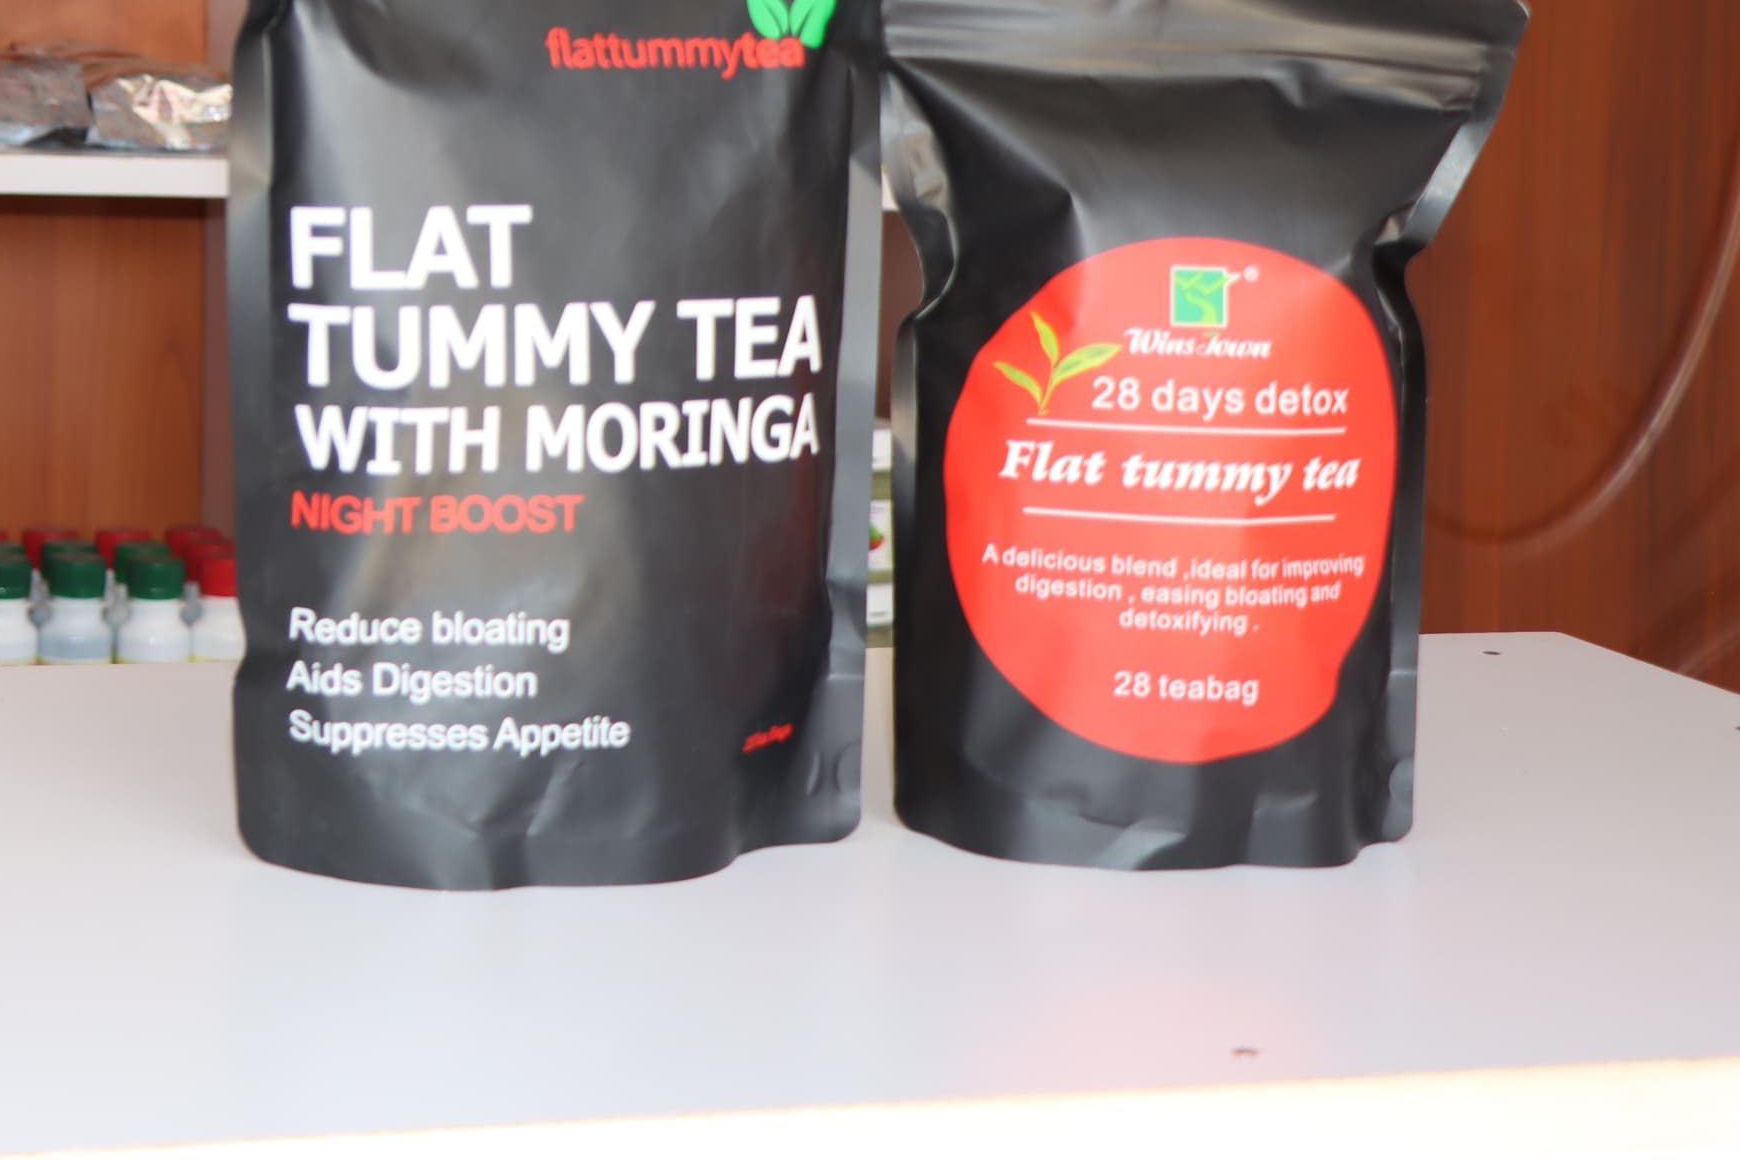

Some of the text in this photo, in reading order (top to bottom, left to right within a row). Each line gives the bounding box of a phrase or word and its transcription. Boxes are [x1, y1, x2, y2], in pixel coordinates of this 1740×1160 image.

[546, 27, 806, 80] flattummytea
[290, 204, 533, 291] FLAT
[287, 295, 823, 389] TUMMY TEA
[1091, 375, 1350, 422] 28 days detox
[295, 393, 820, 476] WITH MORINGA
[999, 439, 1362, 506] Flat tummy tea
[290, 490, 585, 534] NIGHT BOOST
[982, 544, 999, 564] A
[1002, 546, 1106, 574] delicious
[1111, 554, 1177, 578] blend
[1251, 557, 1278, 580] for
[1282, 554, 1365, 578] improving
[1015, 573, 1122, 601] digestion
[1141, 585, 1218, 609] easing
[1225, 582, 1307, 608] bloating
[1311, 581, 1341, 601] and
[289, 606, 571, 654] Reduce bloating
[1119, 608, 1248, 636] detoxifying
[286, 660, 538, 705] Aids Digestion
[1113, 671, 1259, 705] 28 teabag
[289, 710, 631, 758] Suppresses Appetite
